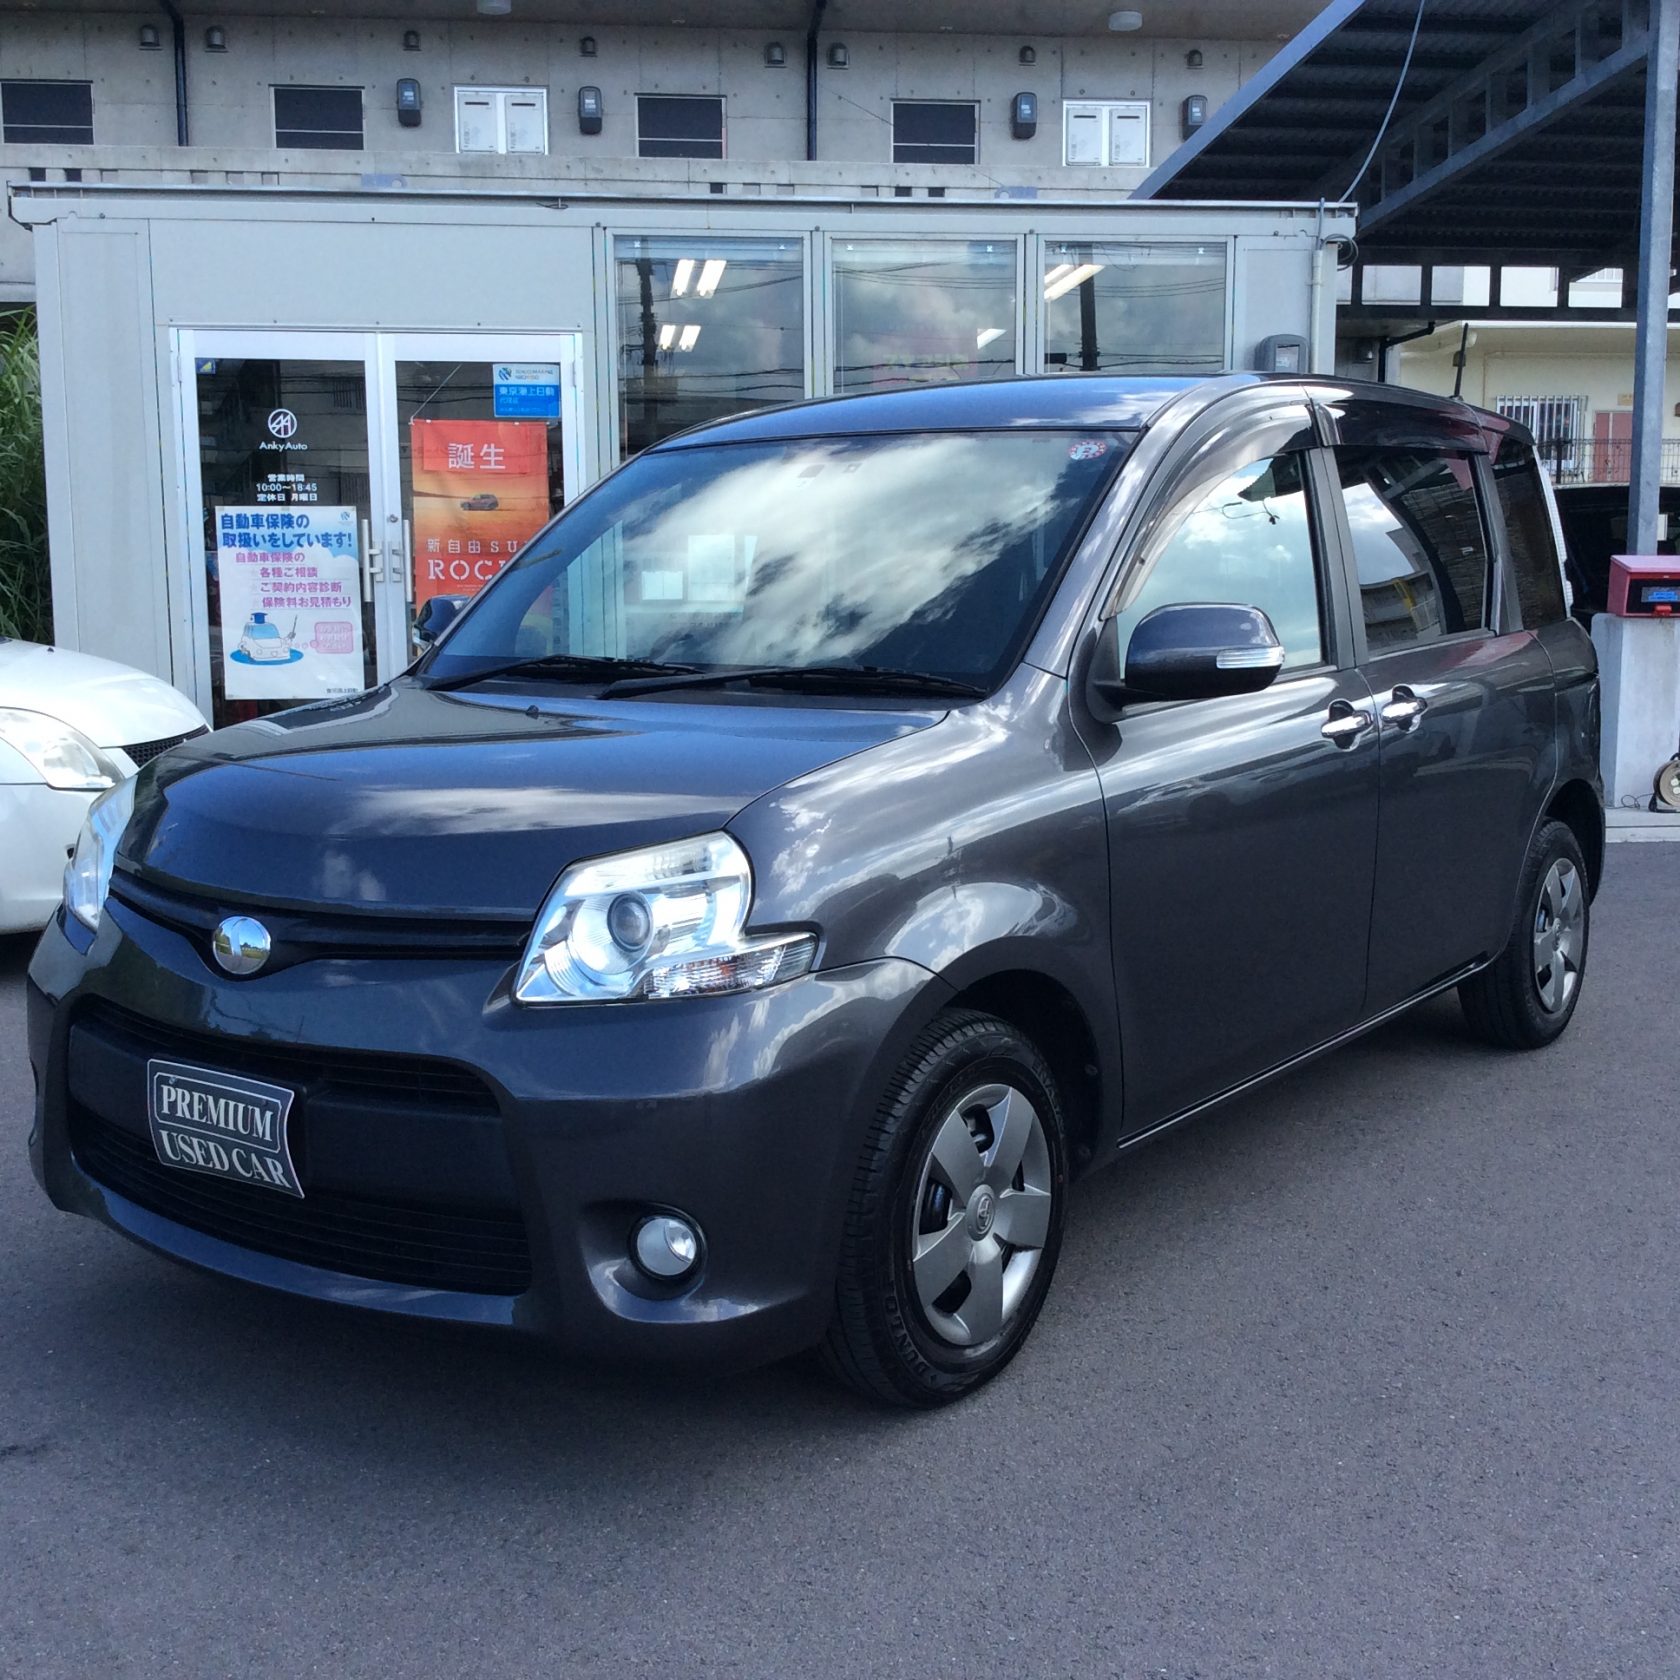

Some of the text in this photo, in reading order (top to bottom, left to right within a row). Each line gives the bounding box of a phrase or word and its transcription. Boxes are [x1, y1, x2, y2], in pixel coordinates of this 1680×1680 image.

[259, 441, 308, 452] Anky Auto
[447, 442, 506, 470] 誕生
[267, 473, 305, 482] 営業時間
[256, 493, 318, 502] 定休日 月曜日
[220, 513, 310, 530] 自動車保険の
[235, 552, 305, 563] 自動車保険の
[260, 566, 318, 578] 各種ご相談
[428, 559, 507, 580] ROC
[260, 582, 342, 593] ご契約内容診断
[262, 597, 351, 608] 保険料お見積もり
[161, 1084, 274, 1142] PREMIUM
[159, 1129, 292, 1188] USED CAR
